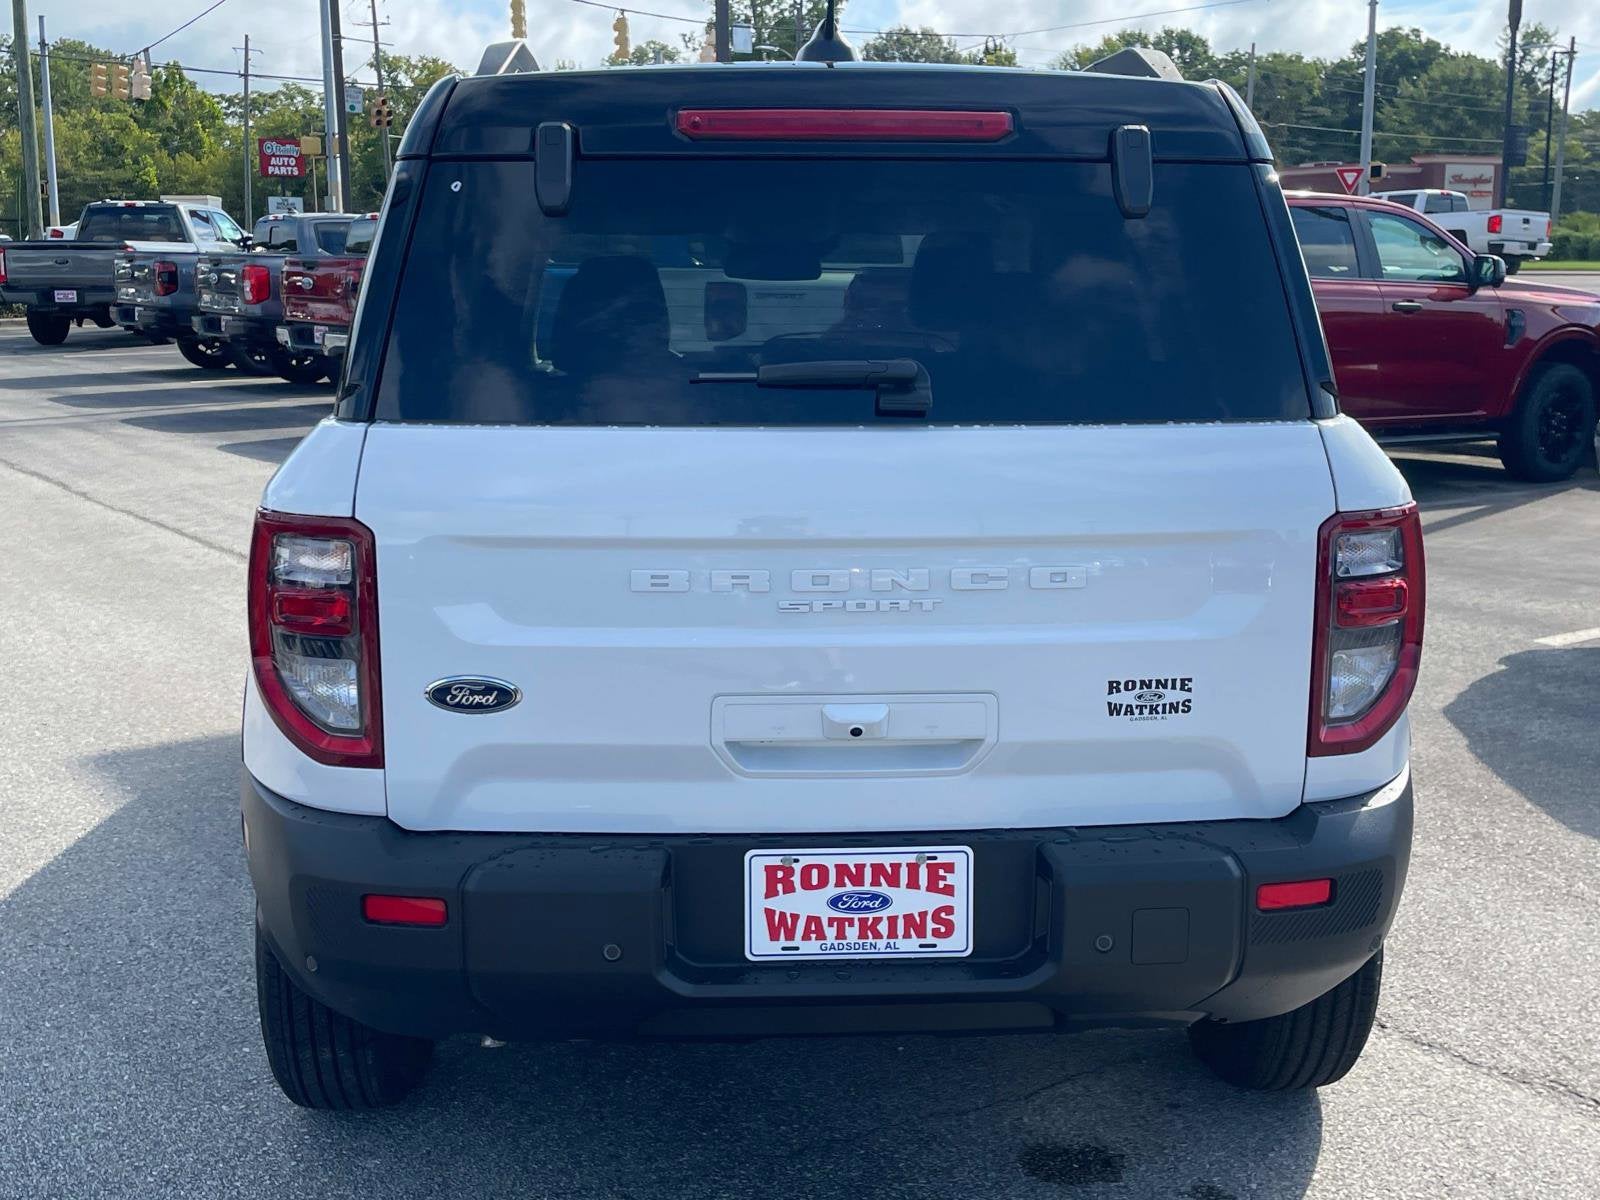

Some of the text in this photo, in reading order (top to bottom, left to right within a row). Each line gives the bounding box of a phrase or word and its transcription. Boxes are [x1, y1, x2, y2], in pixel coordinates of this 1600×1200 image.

[270, 157, 296, 166] AUTO
[268, 166, 299, 175] PARTS
[630, 567, 1087, 592] BRONCO
[777, 598, 943, 612] SPORT
[446, 684, 498, 706] Ford
[1107, 678, 1193, 695] RONNIE
[1107, 699, 1192, 716] WATKINS
[764, 862, 955, 900] RONNIE
[838, 893, 883, 908] Ford
[764, 905, 956, 941] WATKINS
[819, 941, 900, 952] GADSDEN, AL
